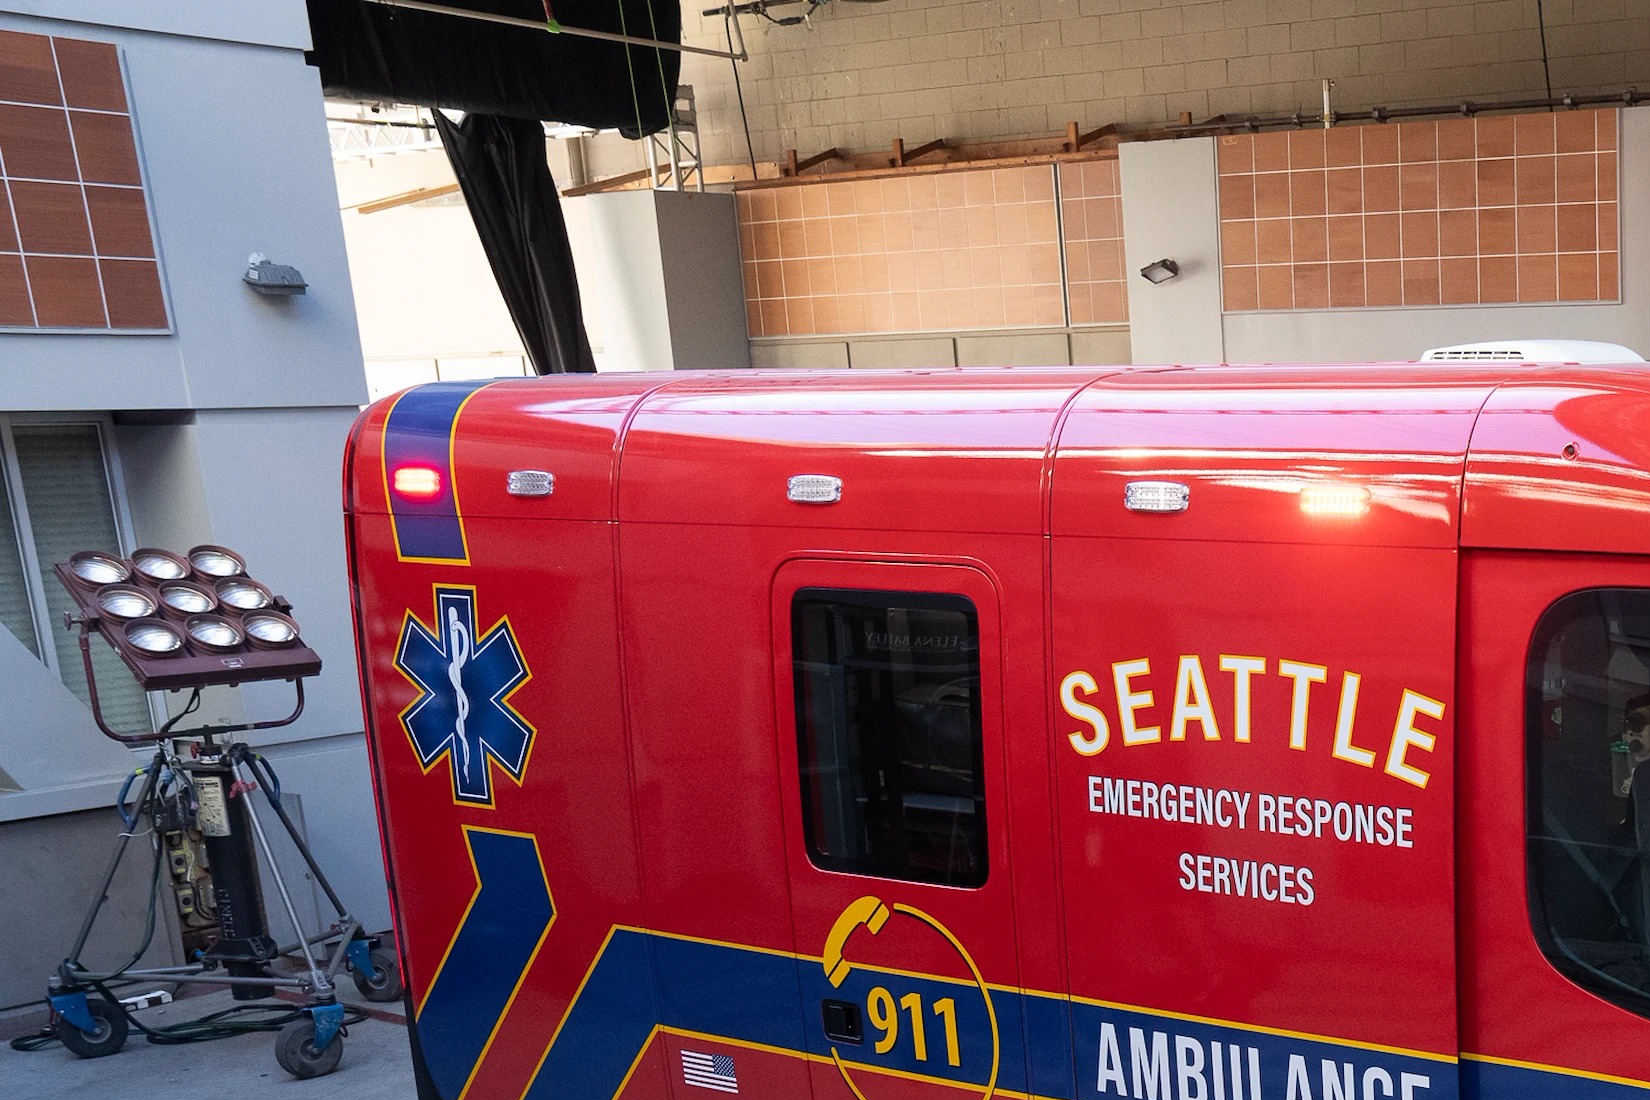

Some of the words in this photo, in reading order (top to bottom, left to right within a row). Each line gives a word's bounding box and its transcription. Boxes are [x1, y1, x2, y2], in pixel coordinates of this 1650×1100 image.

[1059, 653, 1446, 790] SEATTLE
[1088, 775, 1251, 830] EMERGENCY
[1258, 793, 1414, 849] RESPONSE
[1178, 852, 1315, 906] SERVICES
[866, 986, 962, 1070] 911
